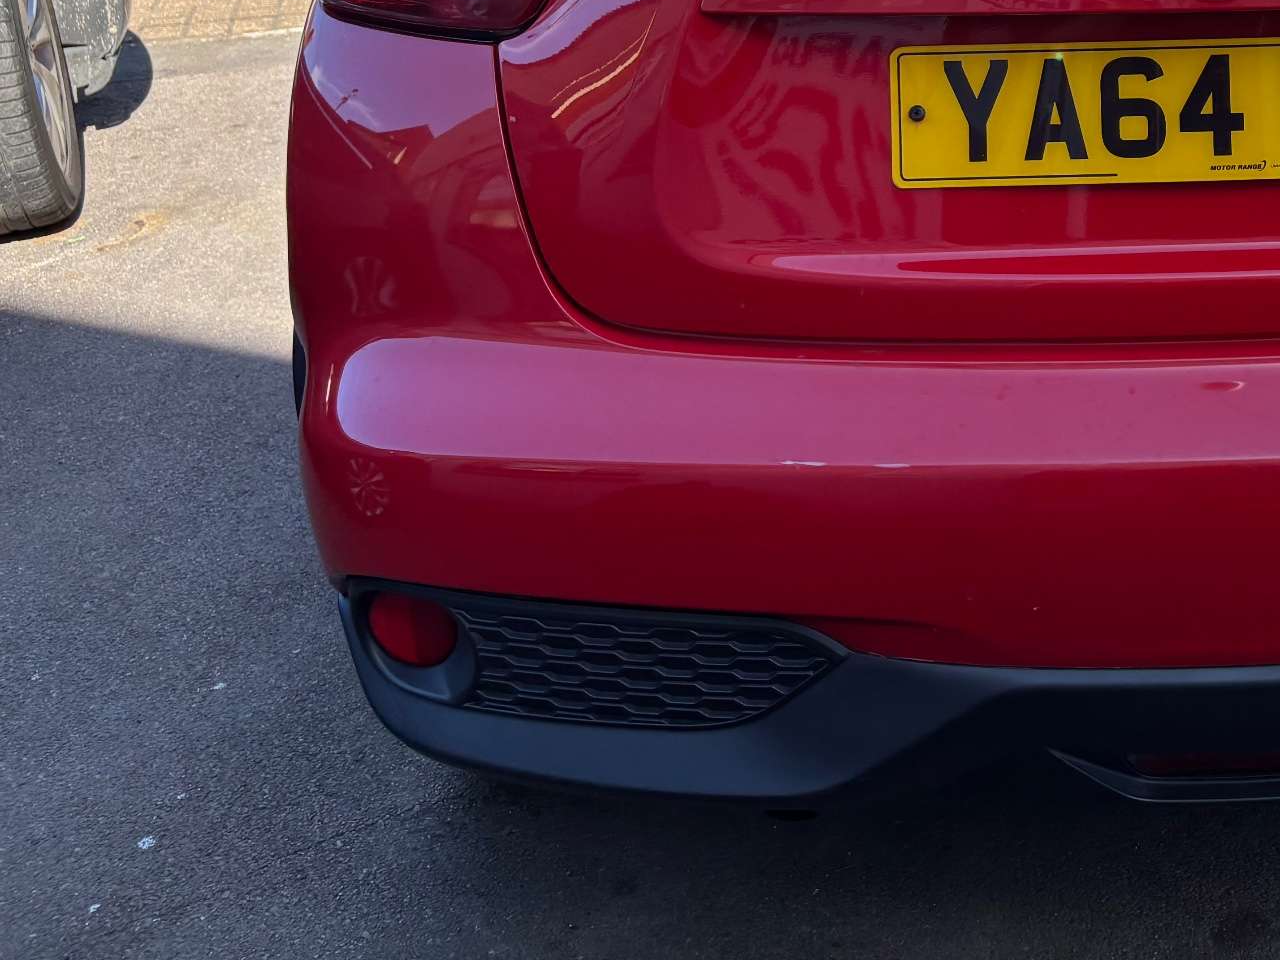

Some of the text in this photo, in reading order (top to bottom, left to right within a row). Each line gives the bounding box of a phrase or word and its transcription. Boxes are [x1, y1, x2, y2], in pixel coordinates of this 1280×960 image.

[943, 53, 1245, 163] YA64
[1210, 163, 1236, 171] MOTOR
[1238, 163, 1262, 171] RANGE
